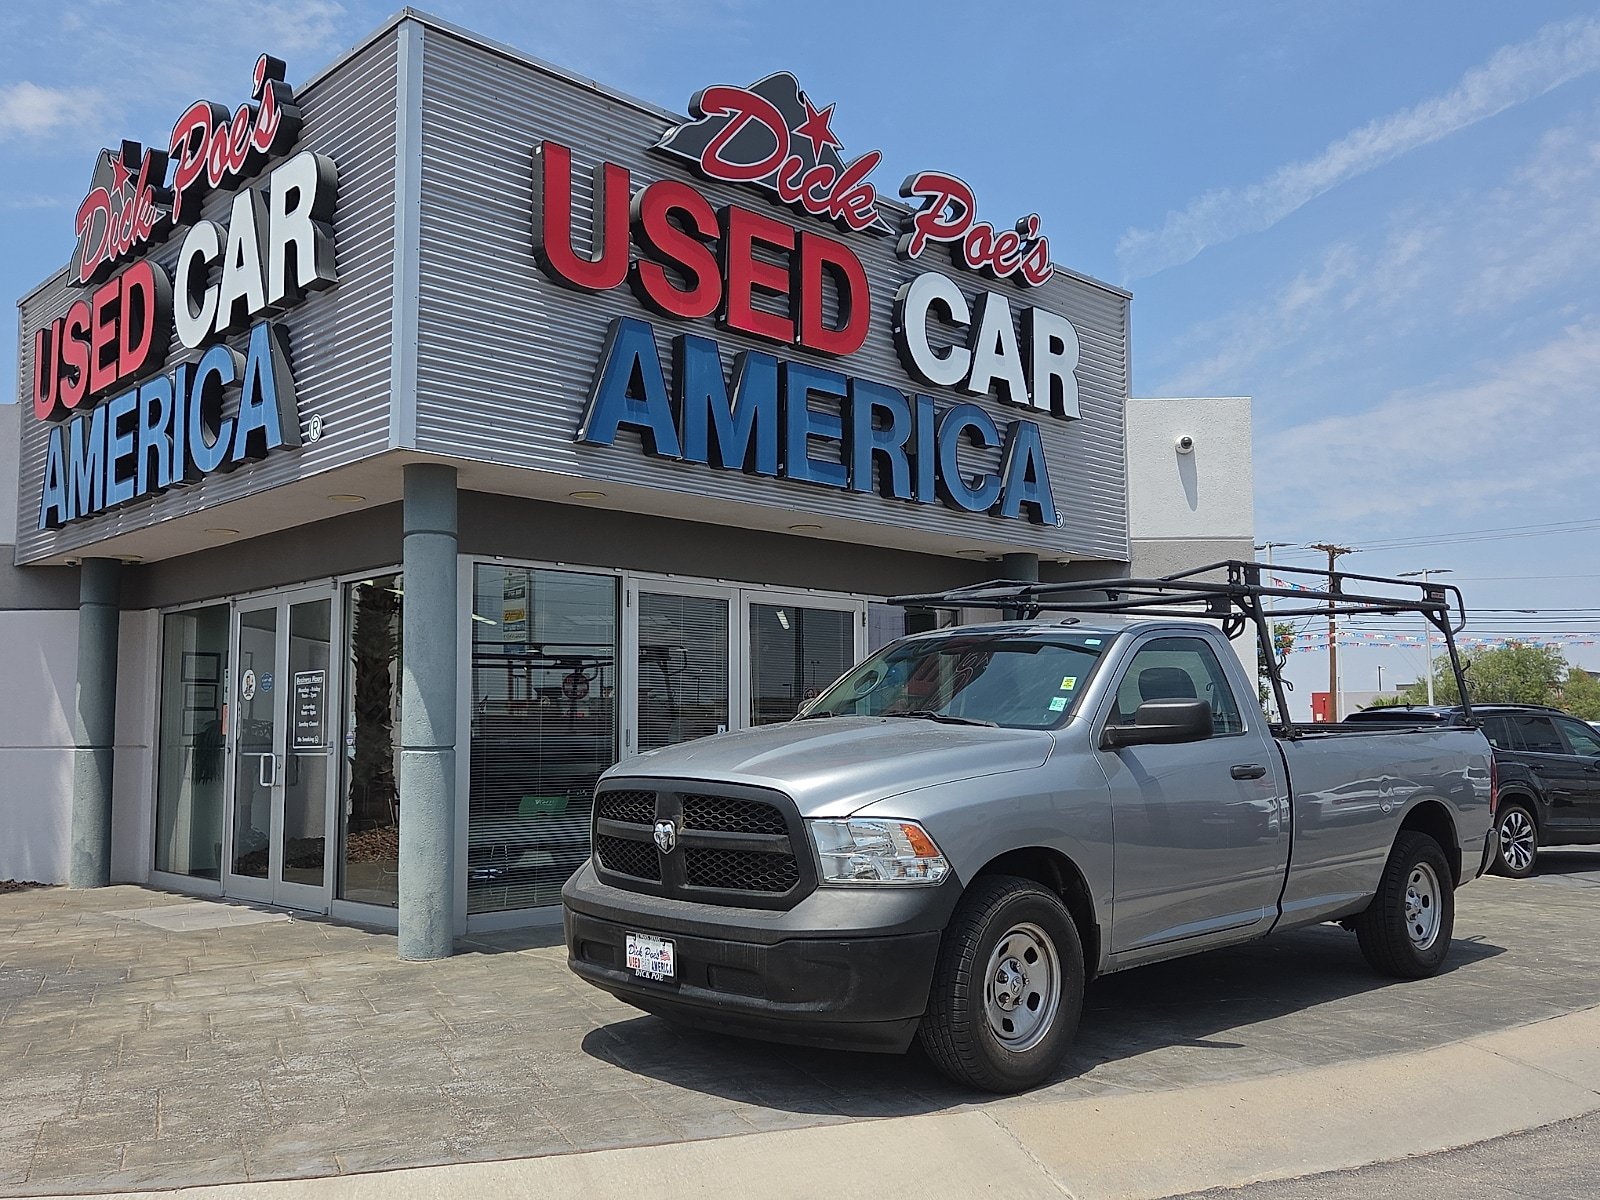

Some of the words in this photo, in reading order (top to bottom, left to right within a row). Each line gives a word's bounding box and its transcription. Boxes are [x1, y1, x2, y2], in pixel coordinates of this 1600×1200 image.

[75, 147, 158, 285] Dick
[169, 52, 284, 225] Poe's
[699, 85, 882, 232] Dick
[906, 171, 1055, 288] Poe's
[34, 260, 156, 421] USED
[173, 151, 321, 349] CAR
[538, 140, 871, 357] USED
[899, 271, 1082, 420] CAR
[38, 321, 286, 531] AMERICA
[578, 316, 1057, 527] AMERICA
[635, 970, 650, 978] DICK
[651, 973, 664, 981] POE
